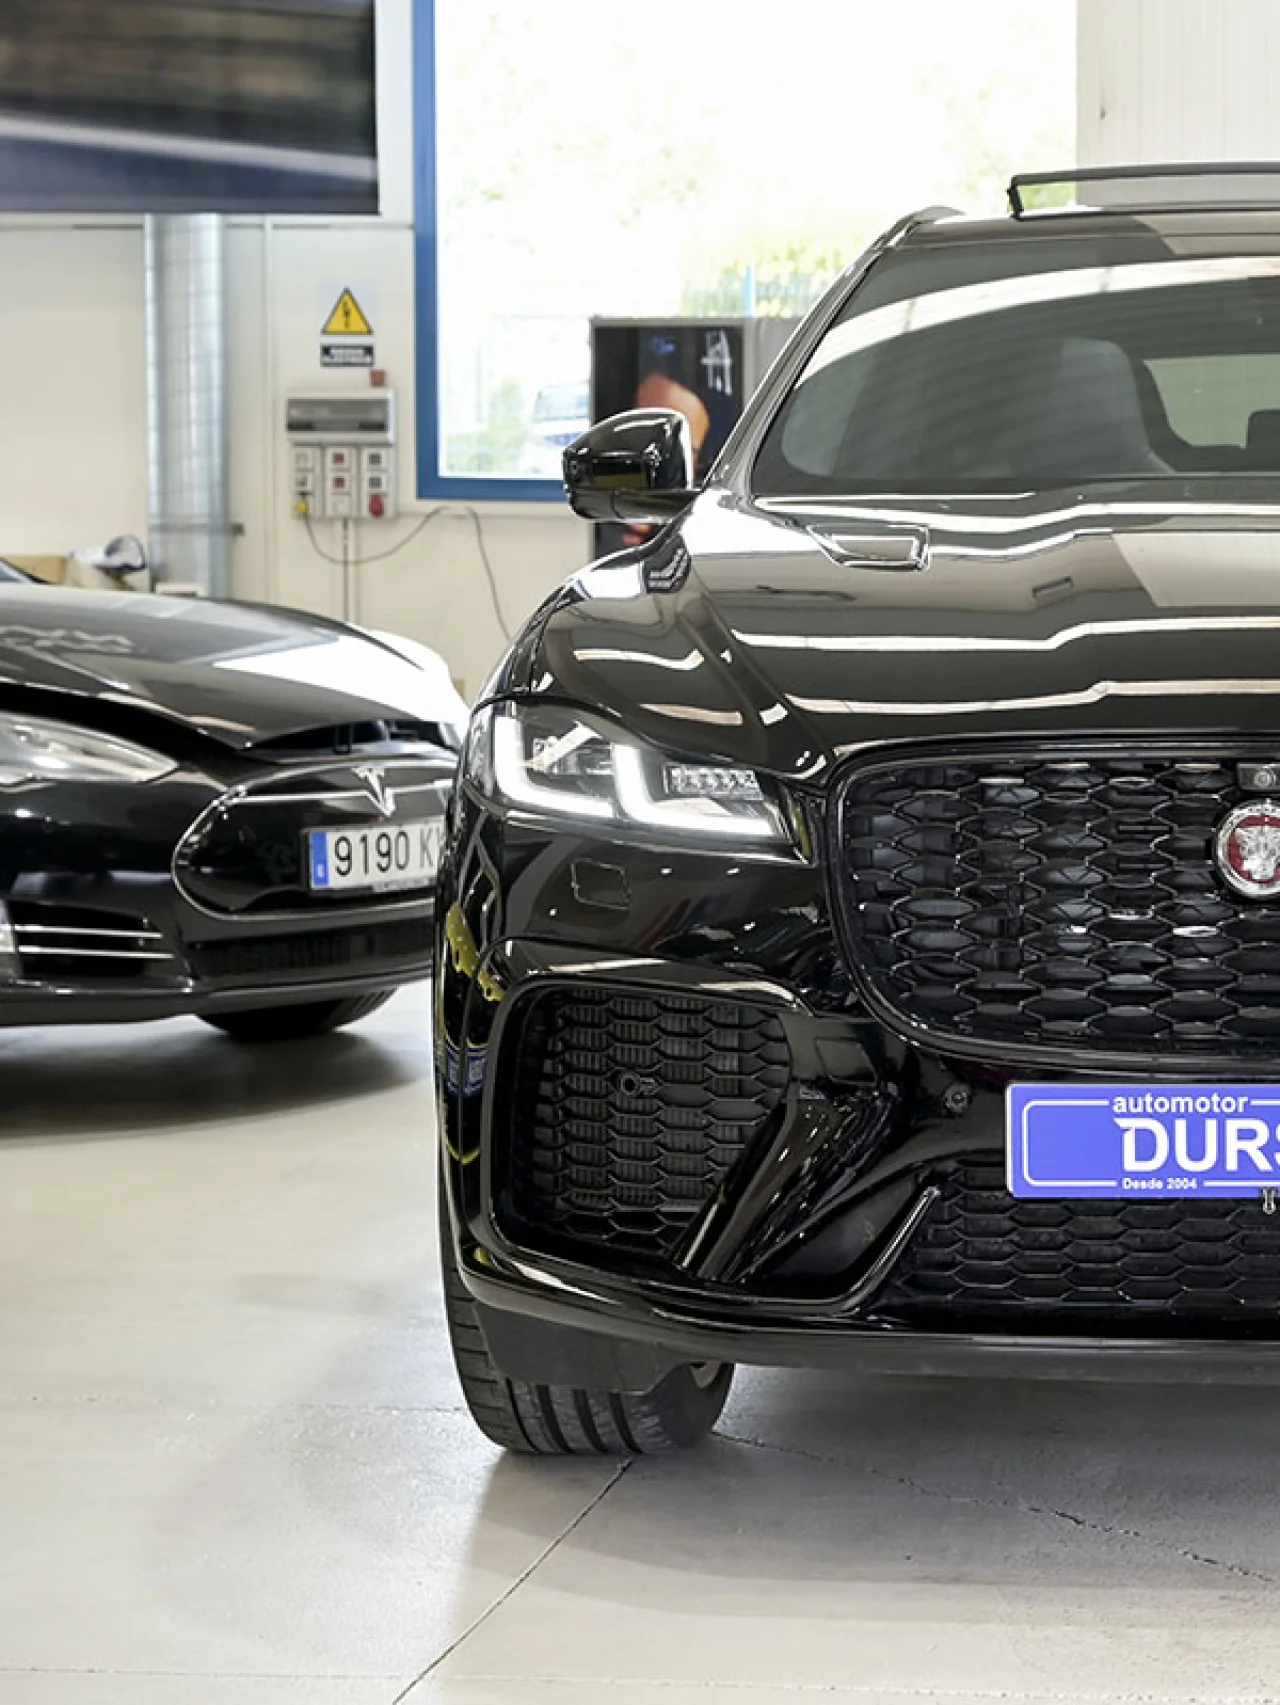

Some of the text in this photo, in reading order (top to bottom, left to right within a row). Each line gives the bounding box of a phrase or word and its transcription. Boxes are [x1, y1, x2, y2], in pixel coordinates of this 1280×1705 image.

[334, 830, 410, 877] 9190
[1112, 1092, 1249, 1113] automotor
[1122, 1177, 1198, 1189] Desde 2004
